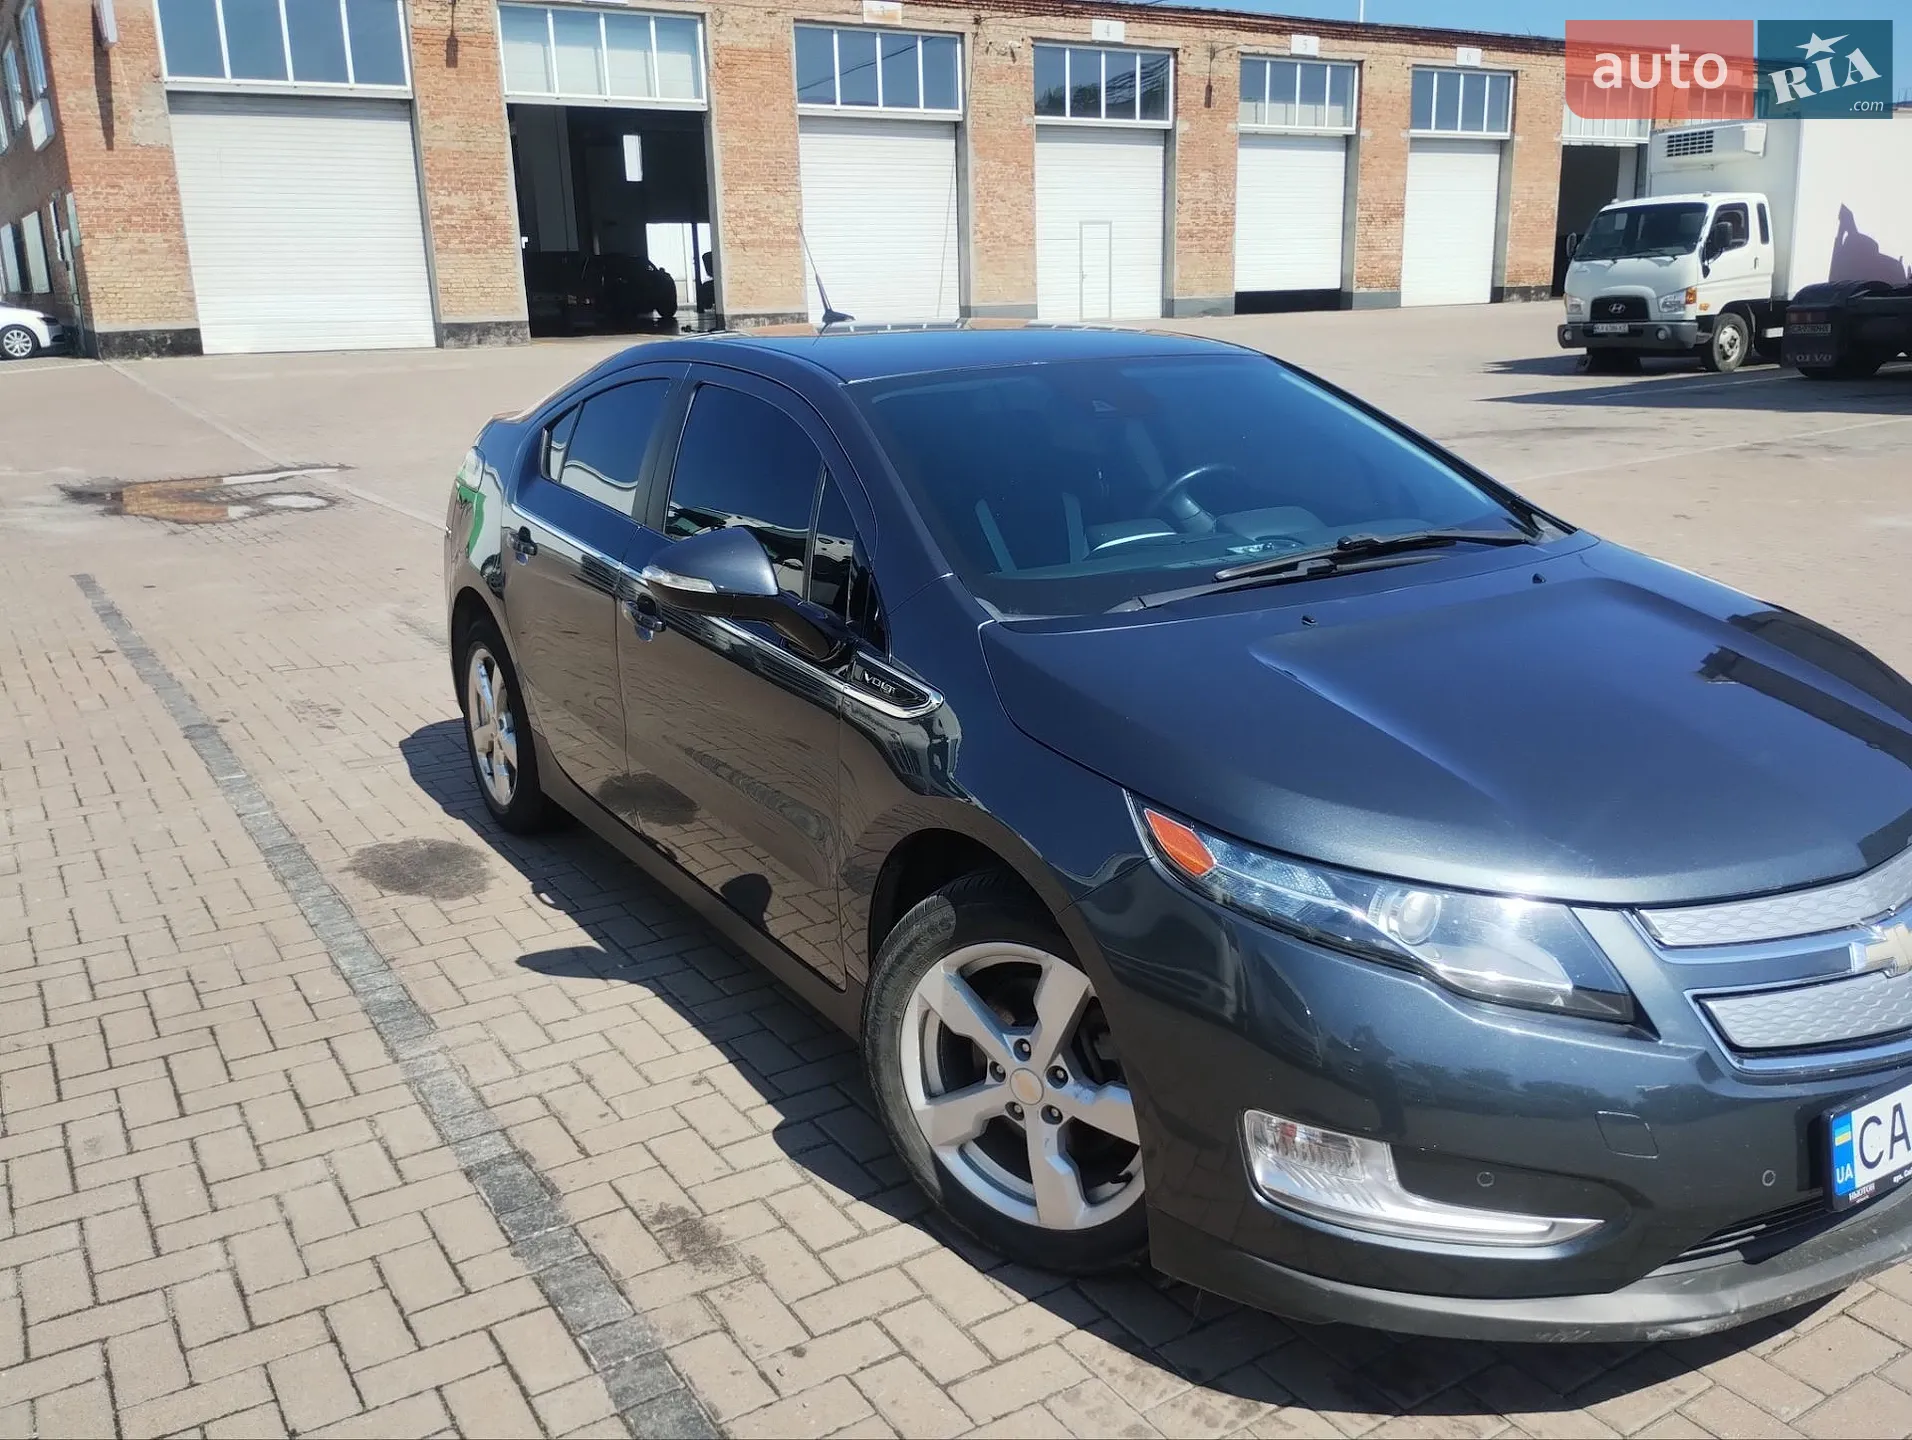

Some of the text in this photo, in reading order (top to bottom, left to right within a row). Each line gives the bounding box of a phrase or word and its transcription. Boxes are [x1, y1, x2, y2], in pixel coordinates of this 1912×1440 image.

[864, 670, 897, 695] VOLT
[1836, 1102, 1912, 1184] UA CA
